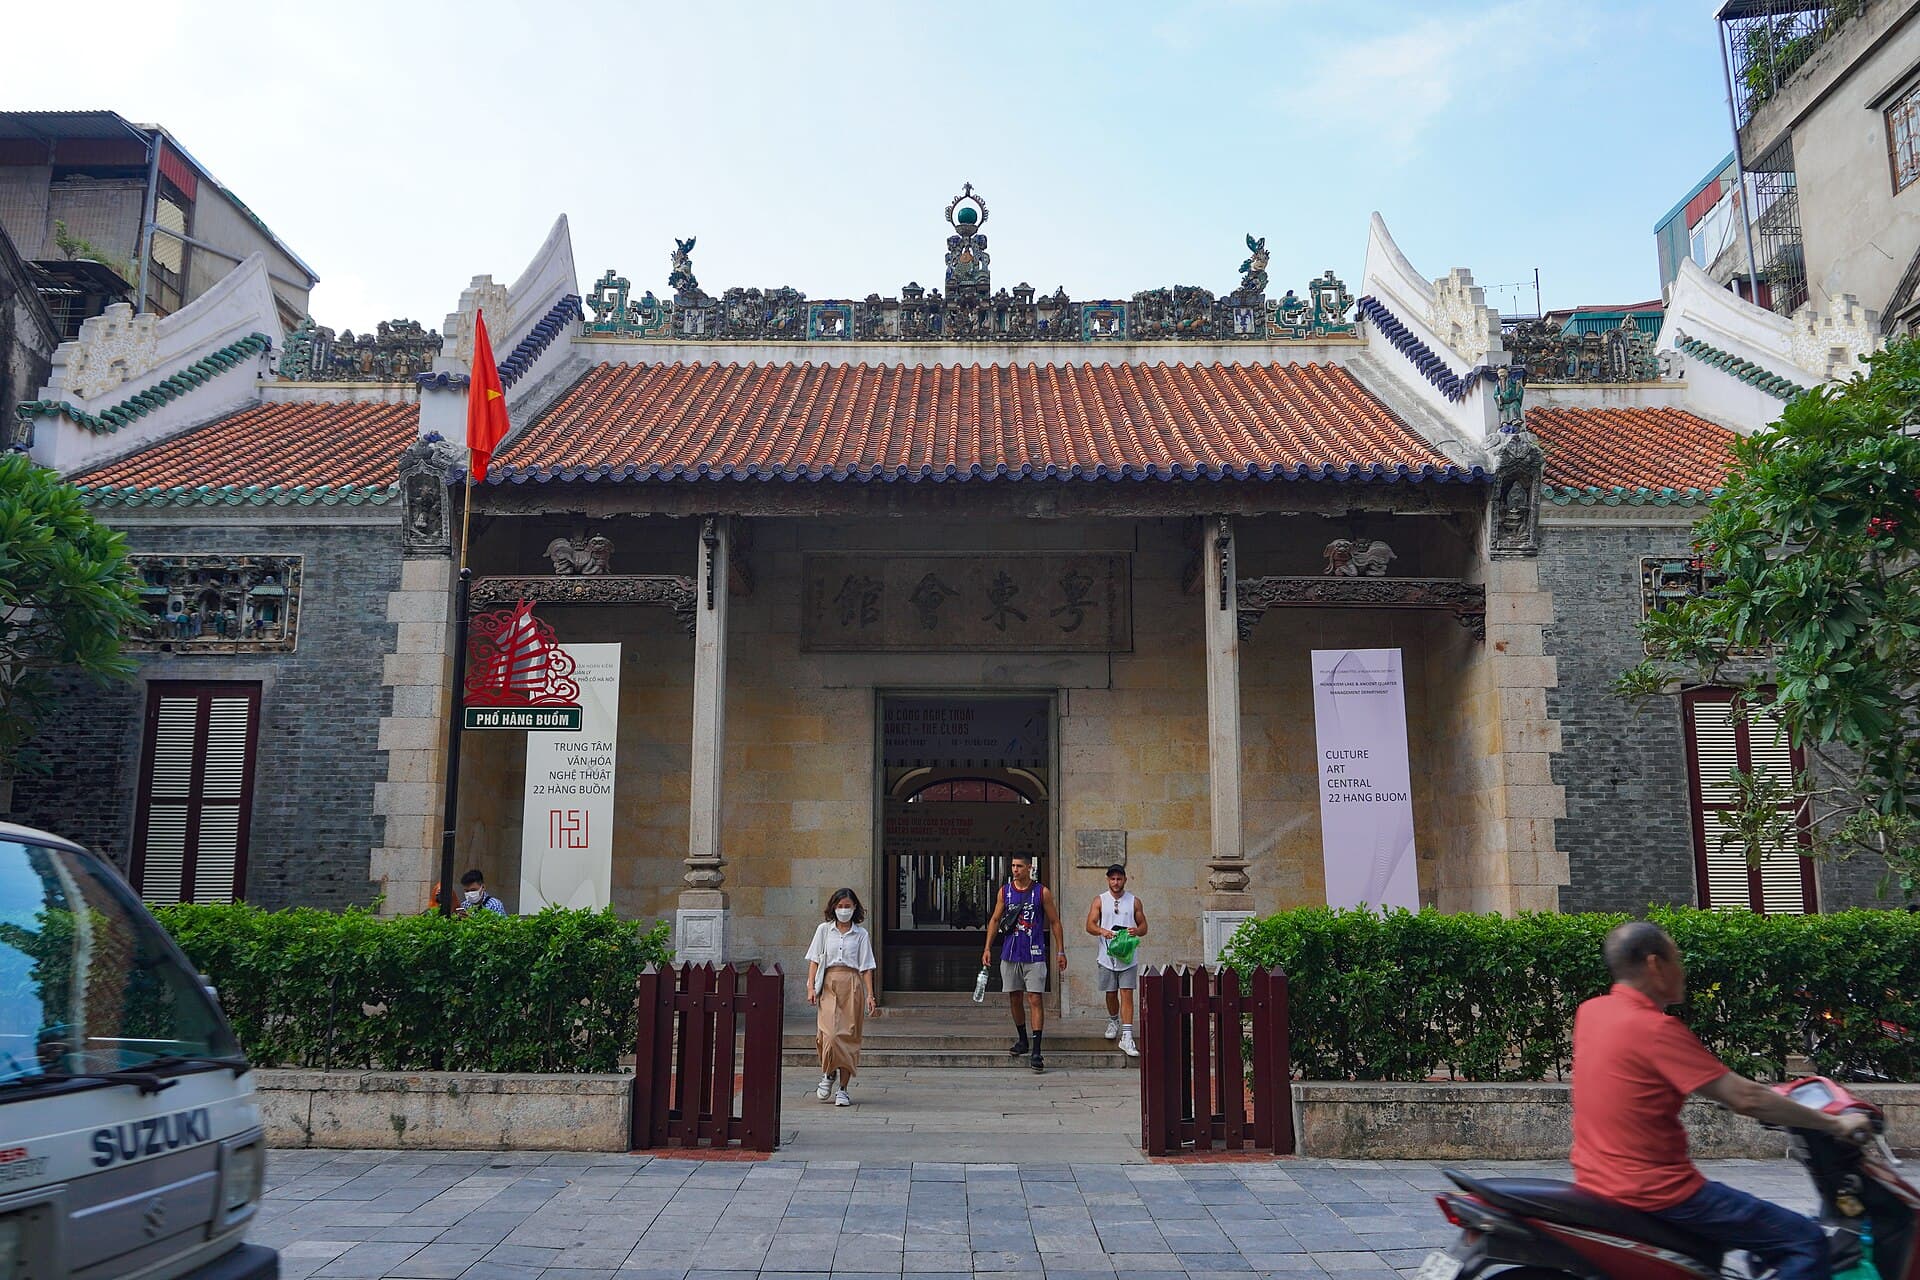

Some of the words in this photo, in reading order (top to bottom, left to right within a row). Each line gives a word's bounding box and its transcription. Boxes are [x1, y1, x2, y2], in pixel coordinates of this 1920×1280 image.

[476, 710, 500, 726] PHỐ
[502, 711, 533, 726] HÀNG
[554, 742, 588, 752] TRUNG
[591, 740, 612, 751] TÂM
[567, 755, 587, 766] VĂN
[590, 755, 612, 766] HÓA
[1325, 750, 1369, 760] CULTURE
[1326, 764, 1346, 774] ART
[549, 769, 577, 781] NGHỆ
[580, 769, 611, 781] THUẬT
[533, 785, 545, 795] 22
[547, 783, 577, 794] HÀNG
[579, 782, 611, 794] BUỒM
[1327, 778, 1372, 788] CENTRAL
[1328, 793, 1341, 803] 22
[1343, 793, 1373, 803] HANG
[1375, 792, 1407, 802] BUOM
[1023, 911, 1035, 920] 21
[90, 1107, 212, 1168] SUZUKI
